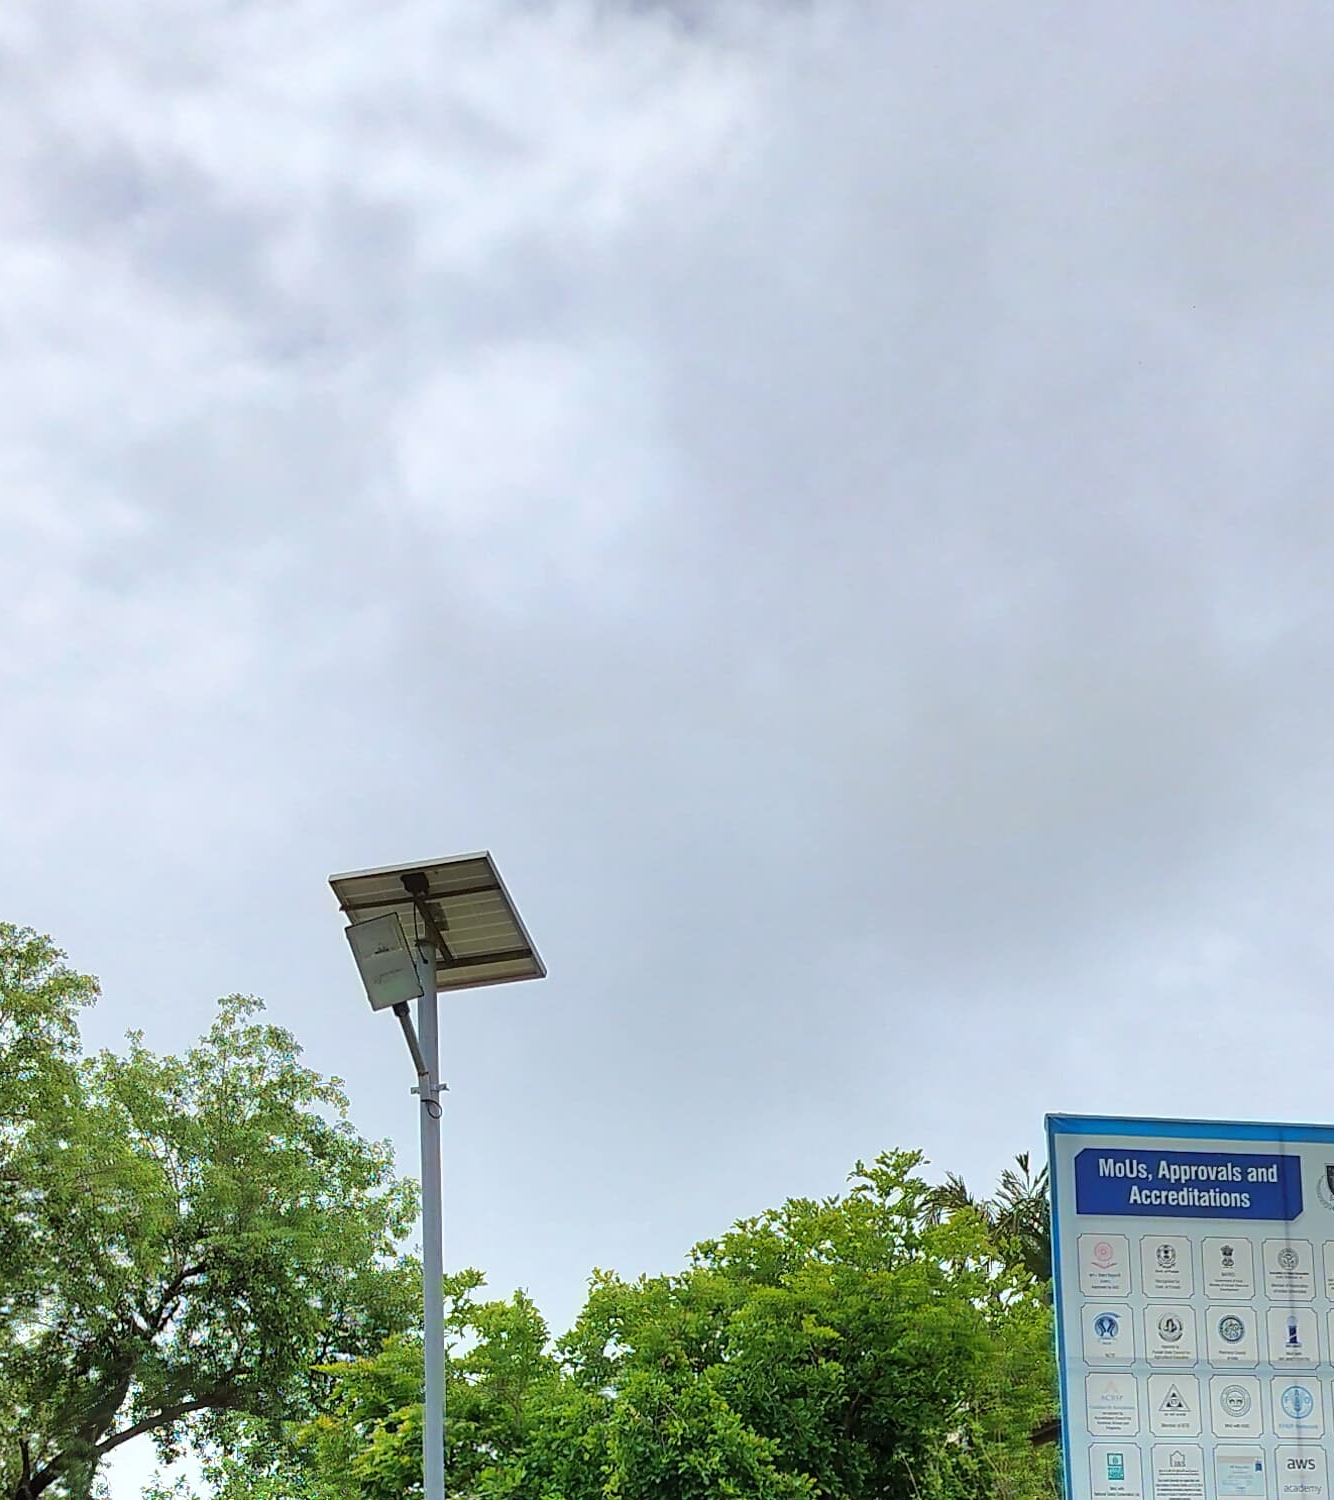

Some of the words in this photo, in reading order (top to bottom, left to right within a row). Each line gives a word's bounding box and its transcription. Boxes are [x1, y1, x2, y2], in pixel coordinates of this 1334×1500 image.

[1098, 1158, 1153, 1182] MoUs,
[1158, 1160, 1242, 1183] Approvals
[1247, 1164, 1278, 1183] and
[1129, 1186, 1251, 1208] Accreditations
[1287, 1458, 1316, 1470] aws
[1283, 1484, 1322, 1495] academy
